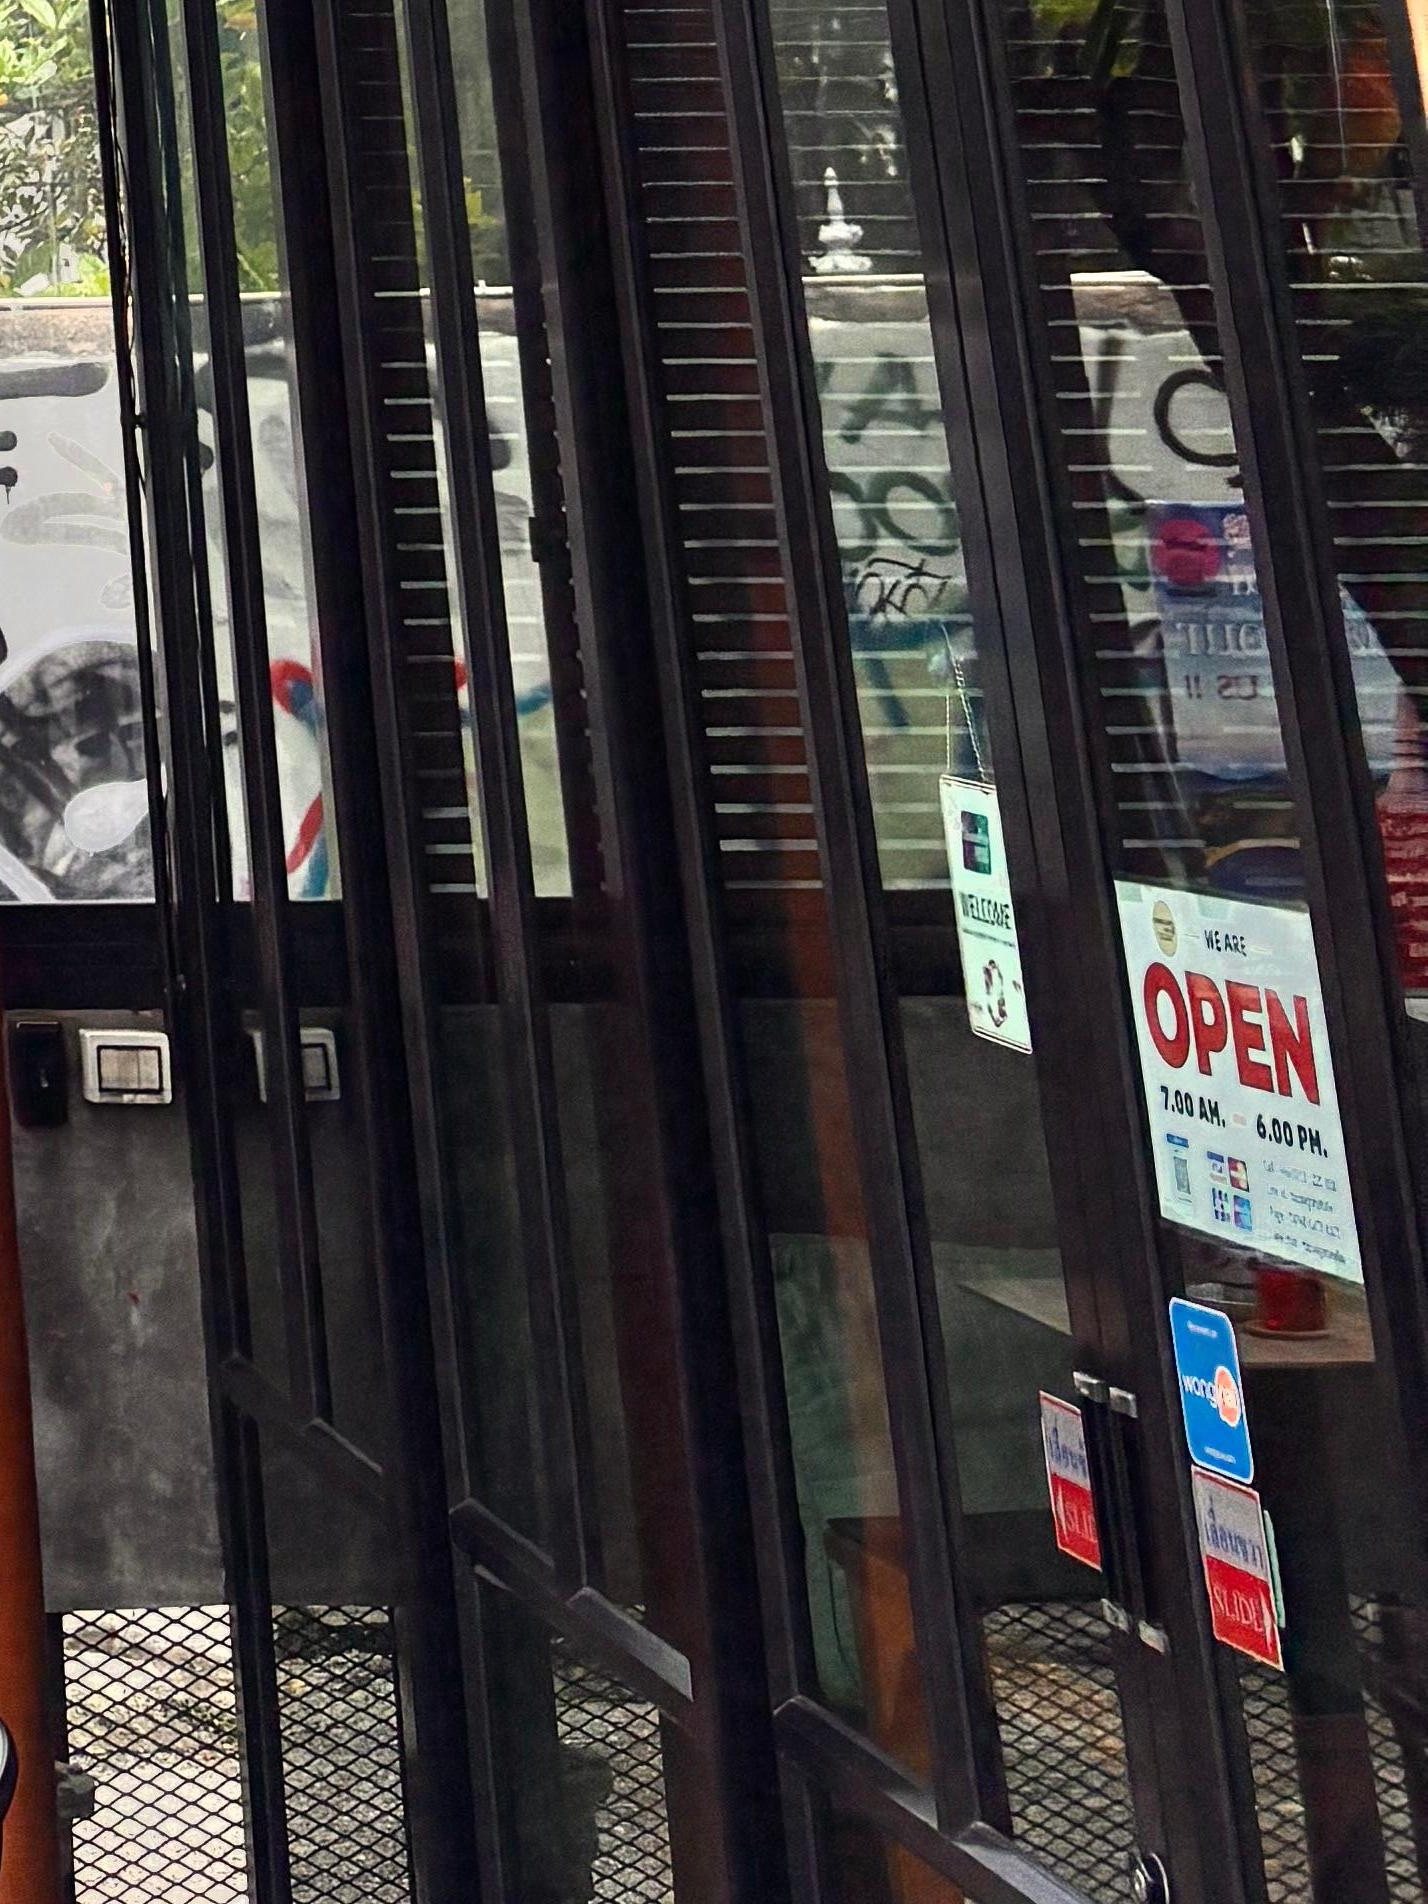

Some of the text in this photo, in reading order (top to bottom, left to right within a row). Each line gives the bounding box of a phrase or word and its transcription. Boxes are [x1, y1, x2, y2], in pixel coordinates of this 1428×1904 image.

[959, 891, 1012, 930] WELCOME
[1203, 929, 1247, 957] WE ARE
[1144, 961, 1321, 1107] OPEN
[1160, 1085, 1195, 1118] 7.00
[1256, 1113, 1294, 1148] 6.00
[1212, 1584, 1264, 1633] SLIDE
